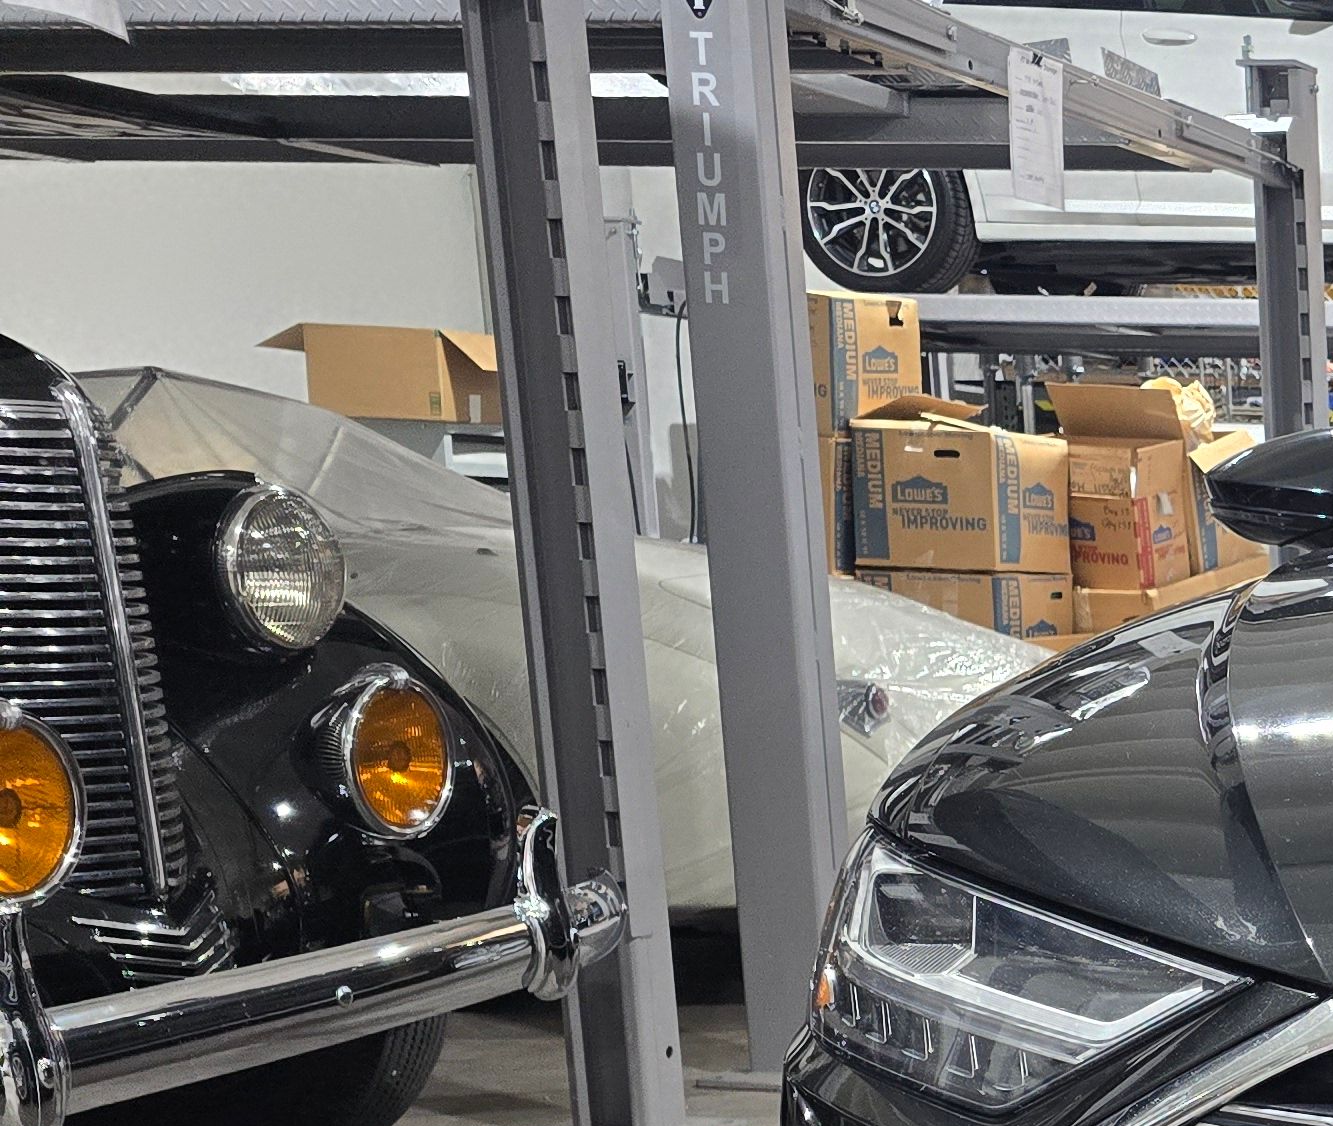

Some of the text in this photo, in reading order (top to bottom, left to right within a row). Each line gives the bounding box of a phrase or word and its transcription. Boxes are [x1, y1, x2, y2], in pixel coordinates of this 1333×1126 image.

[689, 31, 730, 304] TRIUMPH
[842, 302, 857, 380] MEDIUM
[865, 431, 883, 509] MEDIUM
[897, 485, 944, 502] LOWE'S
[1002, 438, 1019, 515] MEDIUM
[901, 513, 987, 531] IMPROVING
[1008, 580, 1021, 638] MEDIU
